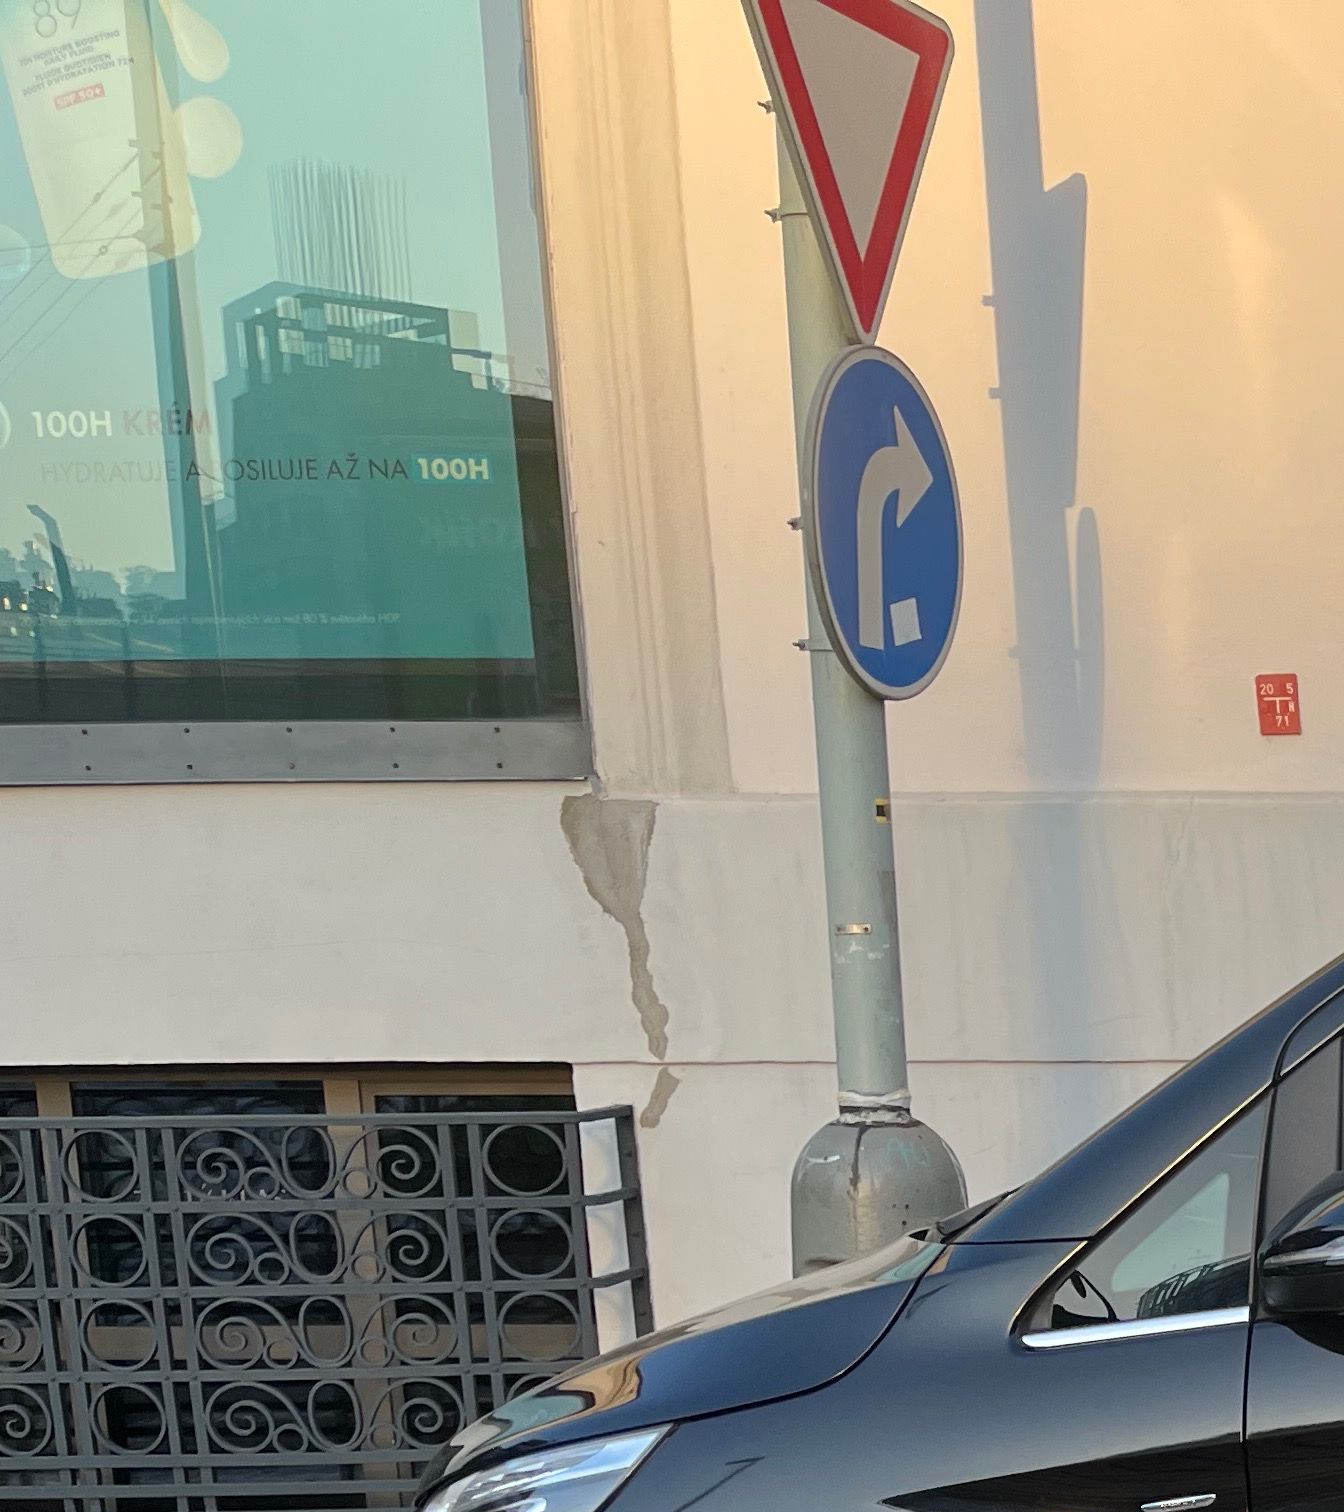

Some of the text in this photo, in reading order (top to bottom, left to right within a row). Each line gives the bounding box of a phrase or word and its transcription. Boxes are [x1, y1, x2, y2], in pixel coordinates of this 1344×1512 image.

[75, 29, 120, 47] BOOSTING
[32, 410, 113, 438] 100H
[41, 452, 490, 483] HYDRATUJE A OSILUJE AŽ NA 100H
[1259, 682, 1294, 695] 20 5
